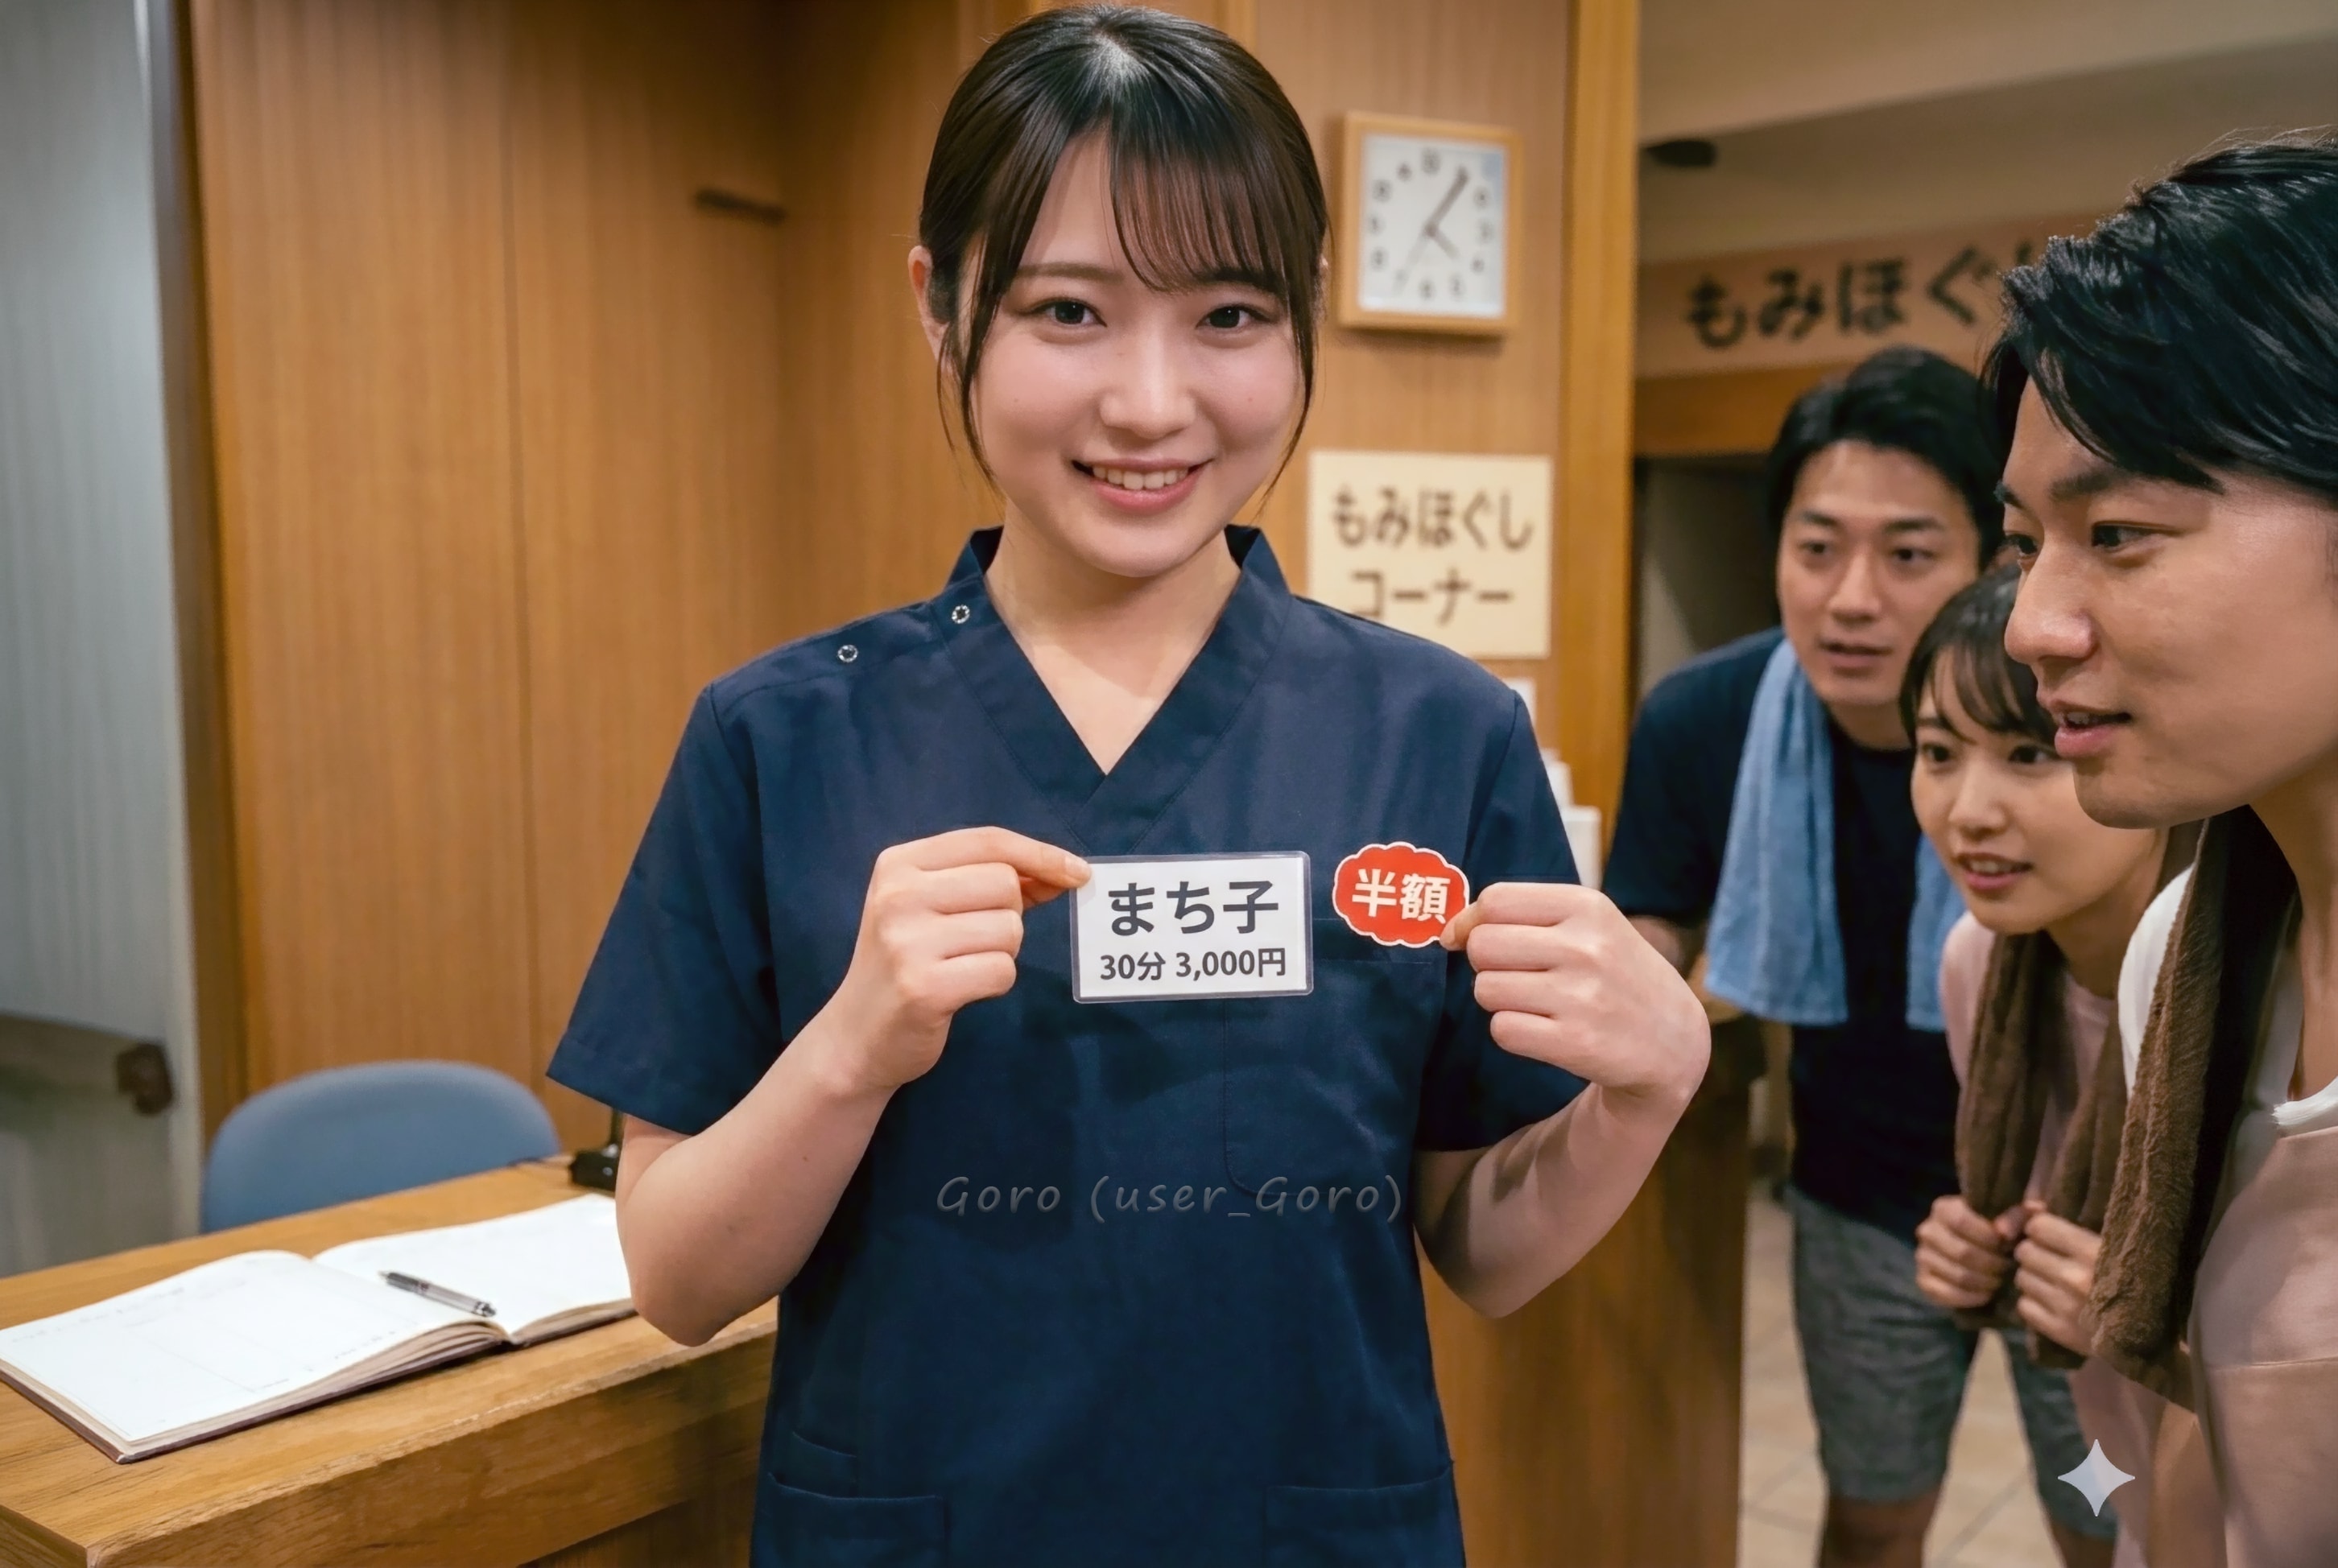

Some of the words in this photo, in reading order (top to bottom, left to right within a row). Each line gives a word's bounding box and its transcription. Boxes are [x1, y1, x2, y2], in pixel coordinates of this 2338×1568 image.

[1689, 239, 2033, 351] もみほぐ
[1333, 486, 1534, 552] もみほぐし
[1350, 567, 1514, 626] コーナー
[1108, 880, 1279, 936] まち子
[1351, 868, 1452, 925] 半額
[1100, 951, 1167, 981] 30分
[1175, 947, 1287, 982] 3,000円
